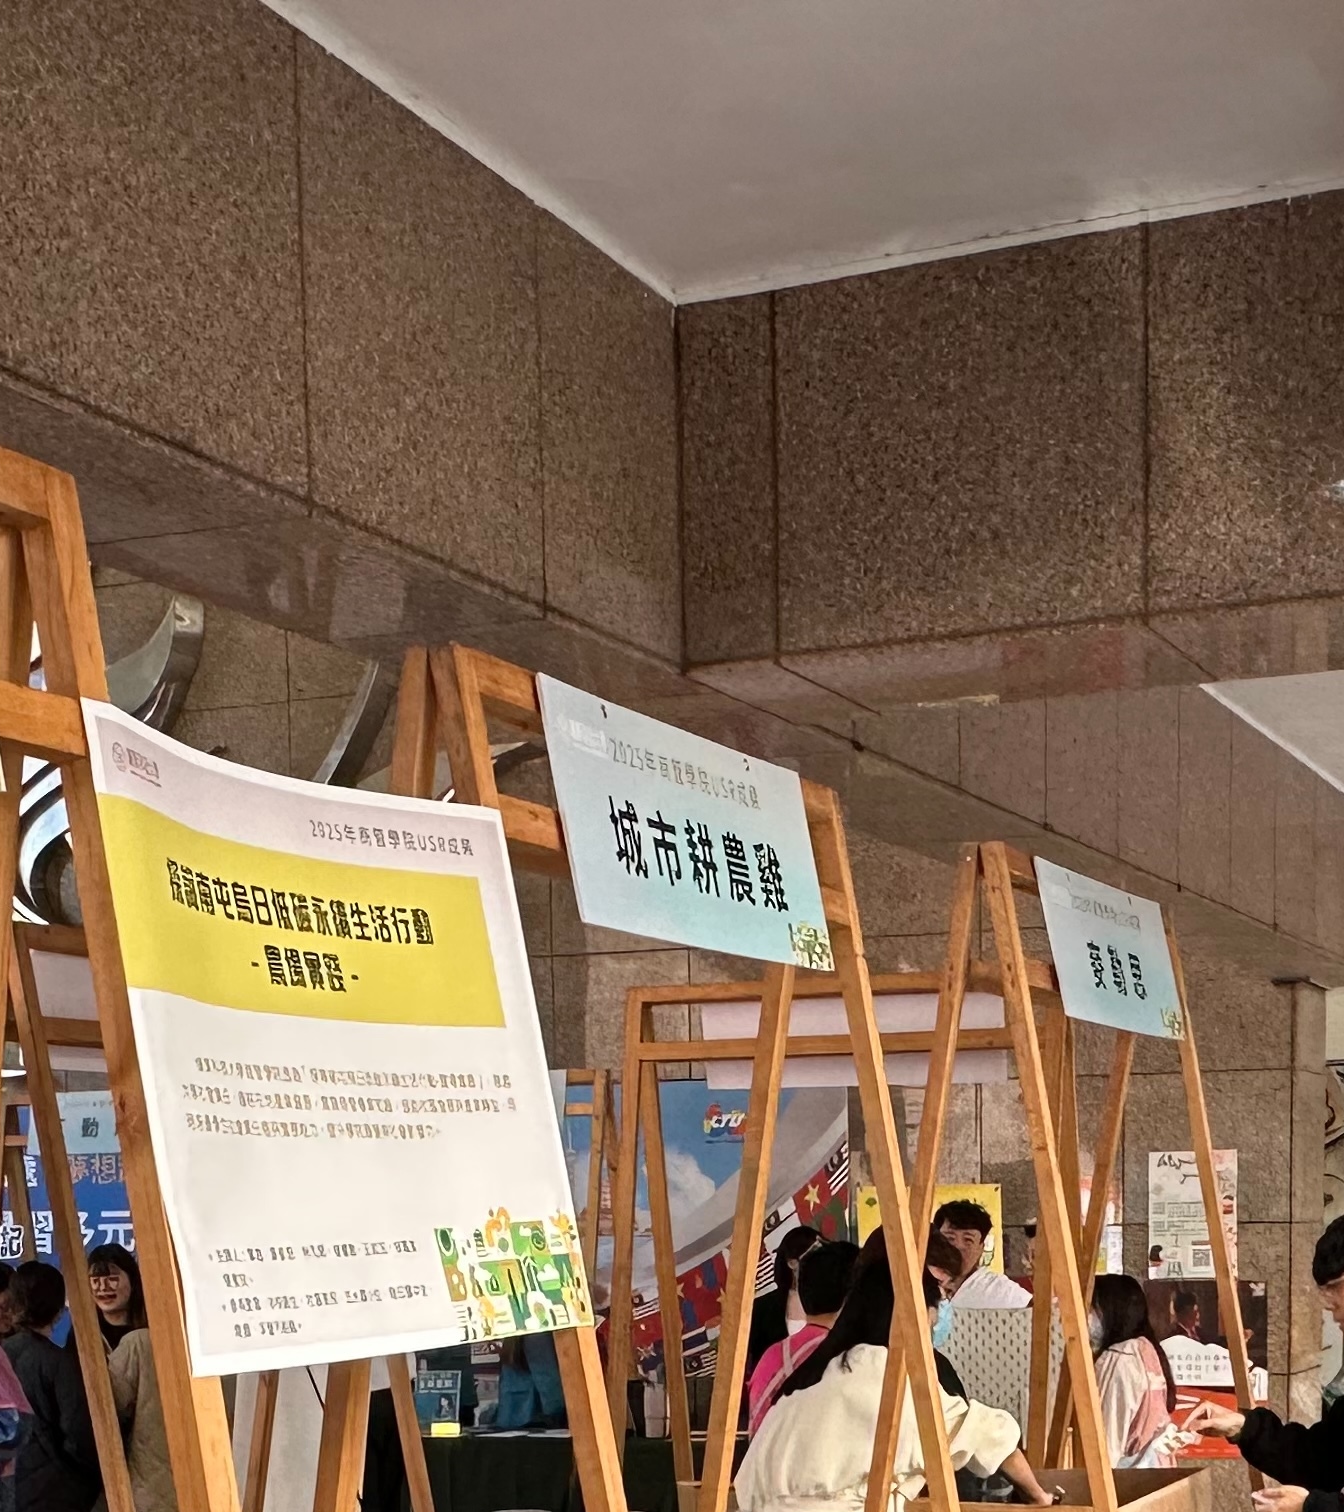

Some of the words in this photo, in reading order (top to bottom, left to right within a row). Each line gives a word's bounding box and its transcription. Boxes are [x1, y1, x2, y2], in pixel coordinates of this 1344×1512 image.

[608, 795, 789, 912] 城市耕農雞
